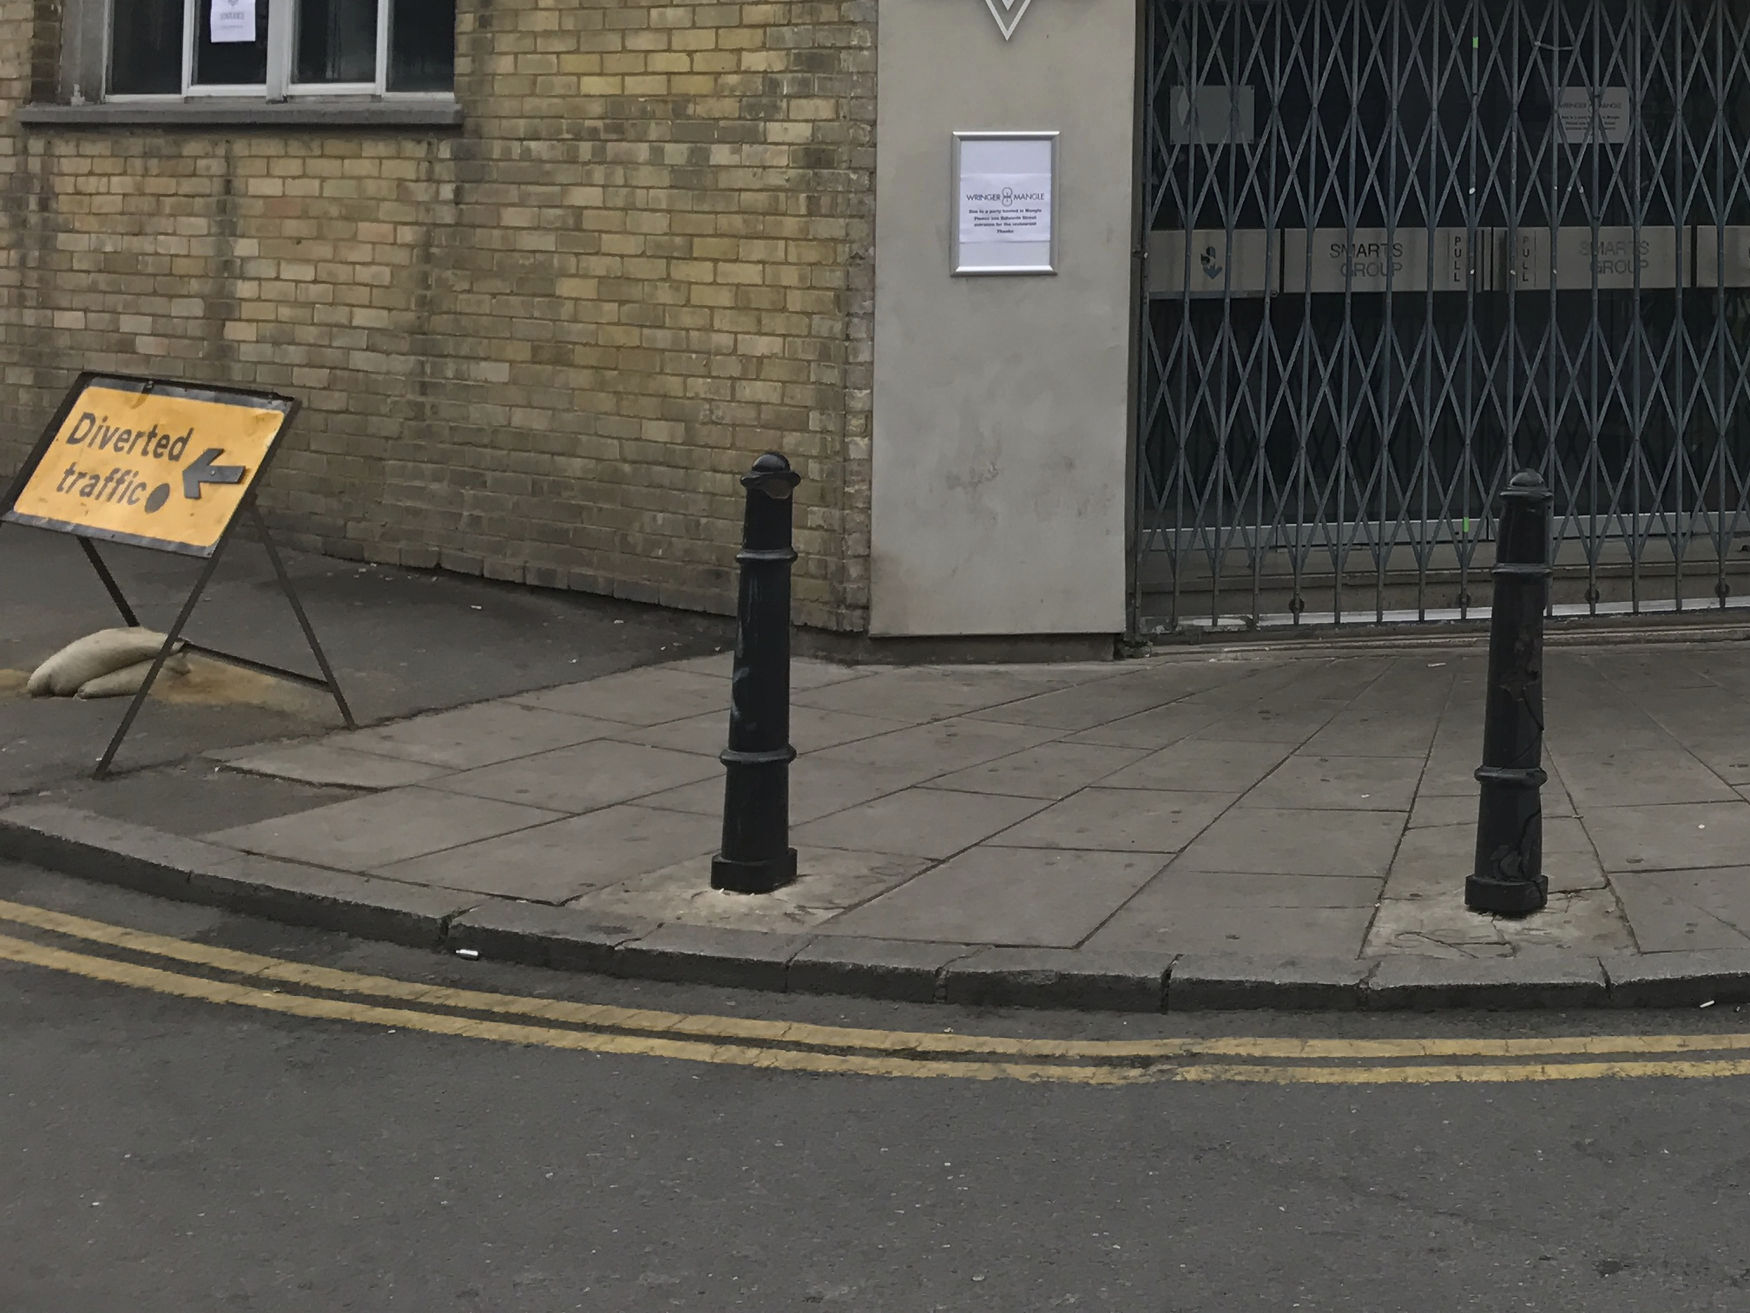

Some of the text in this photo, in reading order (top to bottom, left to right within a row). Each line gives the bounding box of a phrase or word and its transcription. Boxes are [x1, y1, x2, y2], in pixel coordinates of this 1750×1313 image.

[966, 192, 1044, 201] WRINGER MANGLE
[1340, 261, 1403, 277] GROUP
[1454, 236, 1462, 282] PULL
[1522, 236, 1530, 282] PULL
[1590, 259, 1650, 274] GROUP
[66, 412, 194, 462] Diverted
[55, 462, 147, 506] traffic
